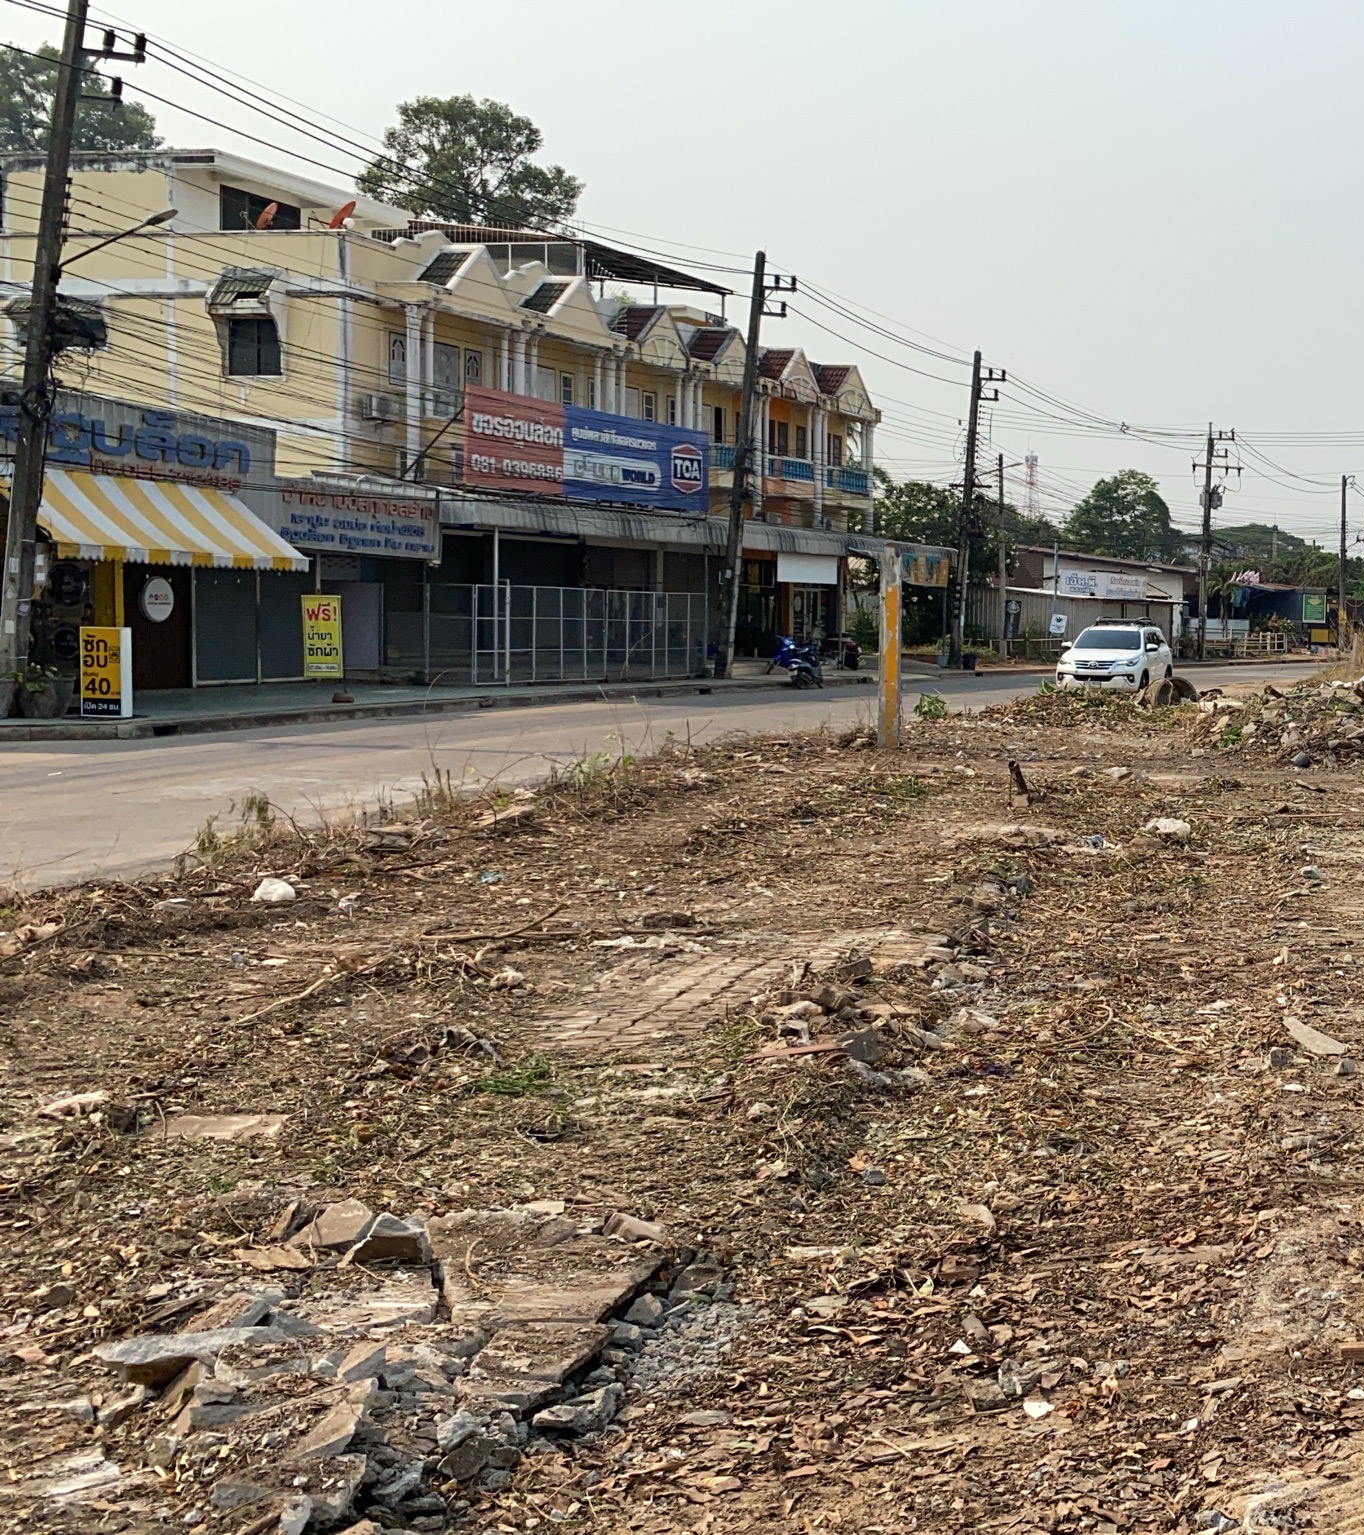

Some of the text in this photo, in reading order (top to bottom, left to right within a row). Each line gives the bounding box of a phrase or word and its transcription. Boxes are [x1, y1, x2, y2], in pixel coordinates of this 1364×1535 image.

[674, 459, 701, 480] TOA
[306, 602, 337, 622] ฟรี!
[307, 625, 333, 641] น้ำยา
[83, 633, 108, 653] ซัก
[307, 643, 339, 657] ซักผ้า
[83, 654, 108, 669] อบ
[85, 678, 110, 695] 40
[84, 701, 97, 710] เปิด
